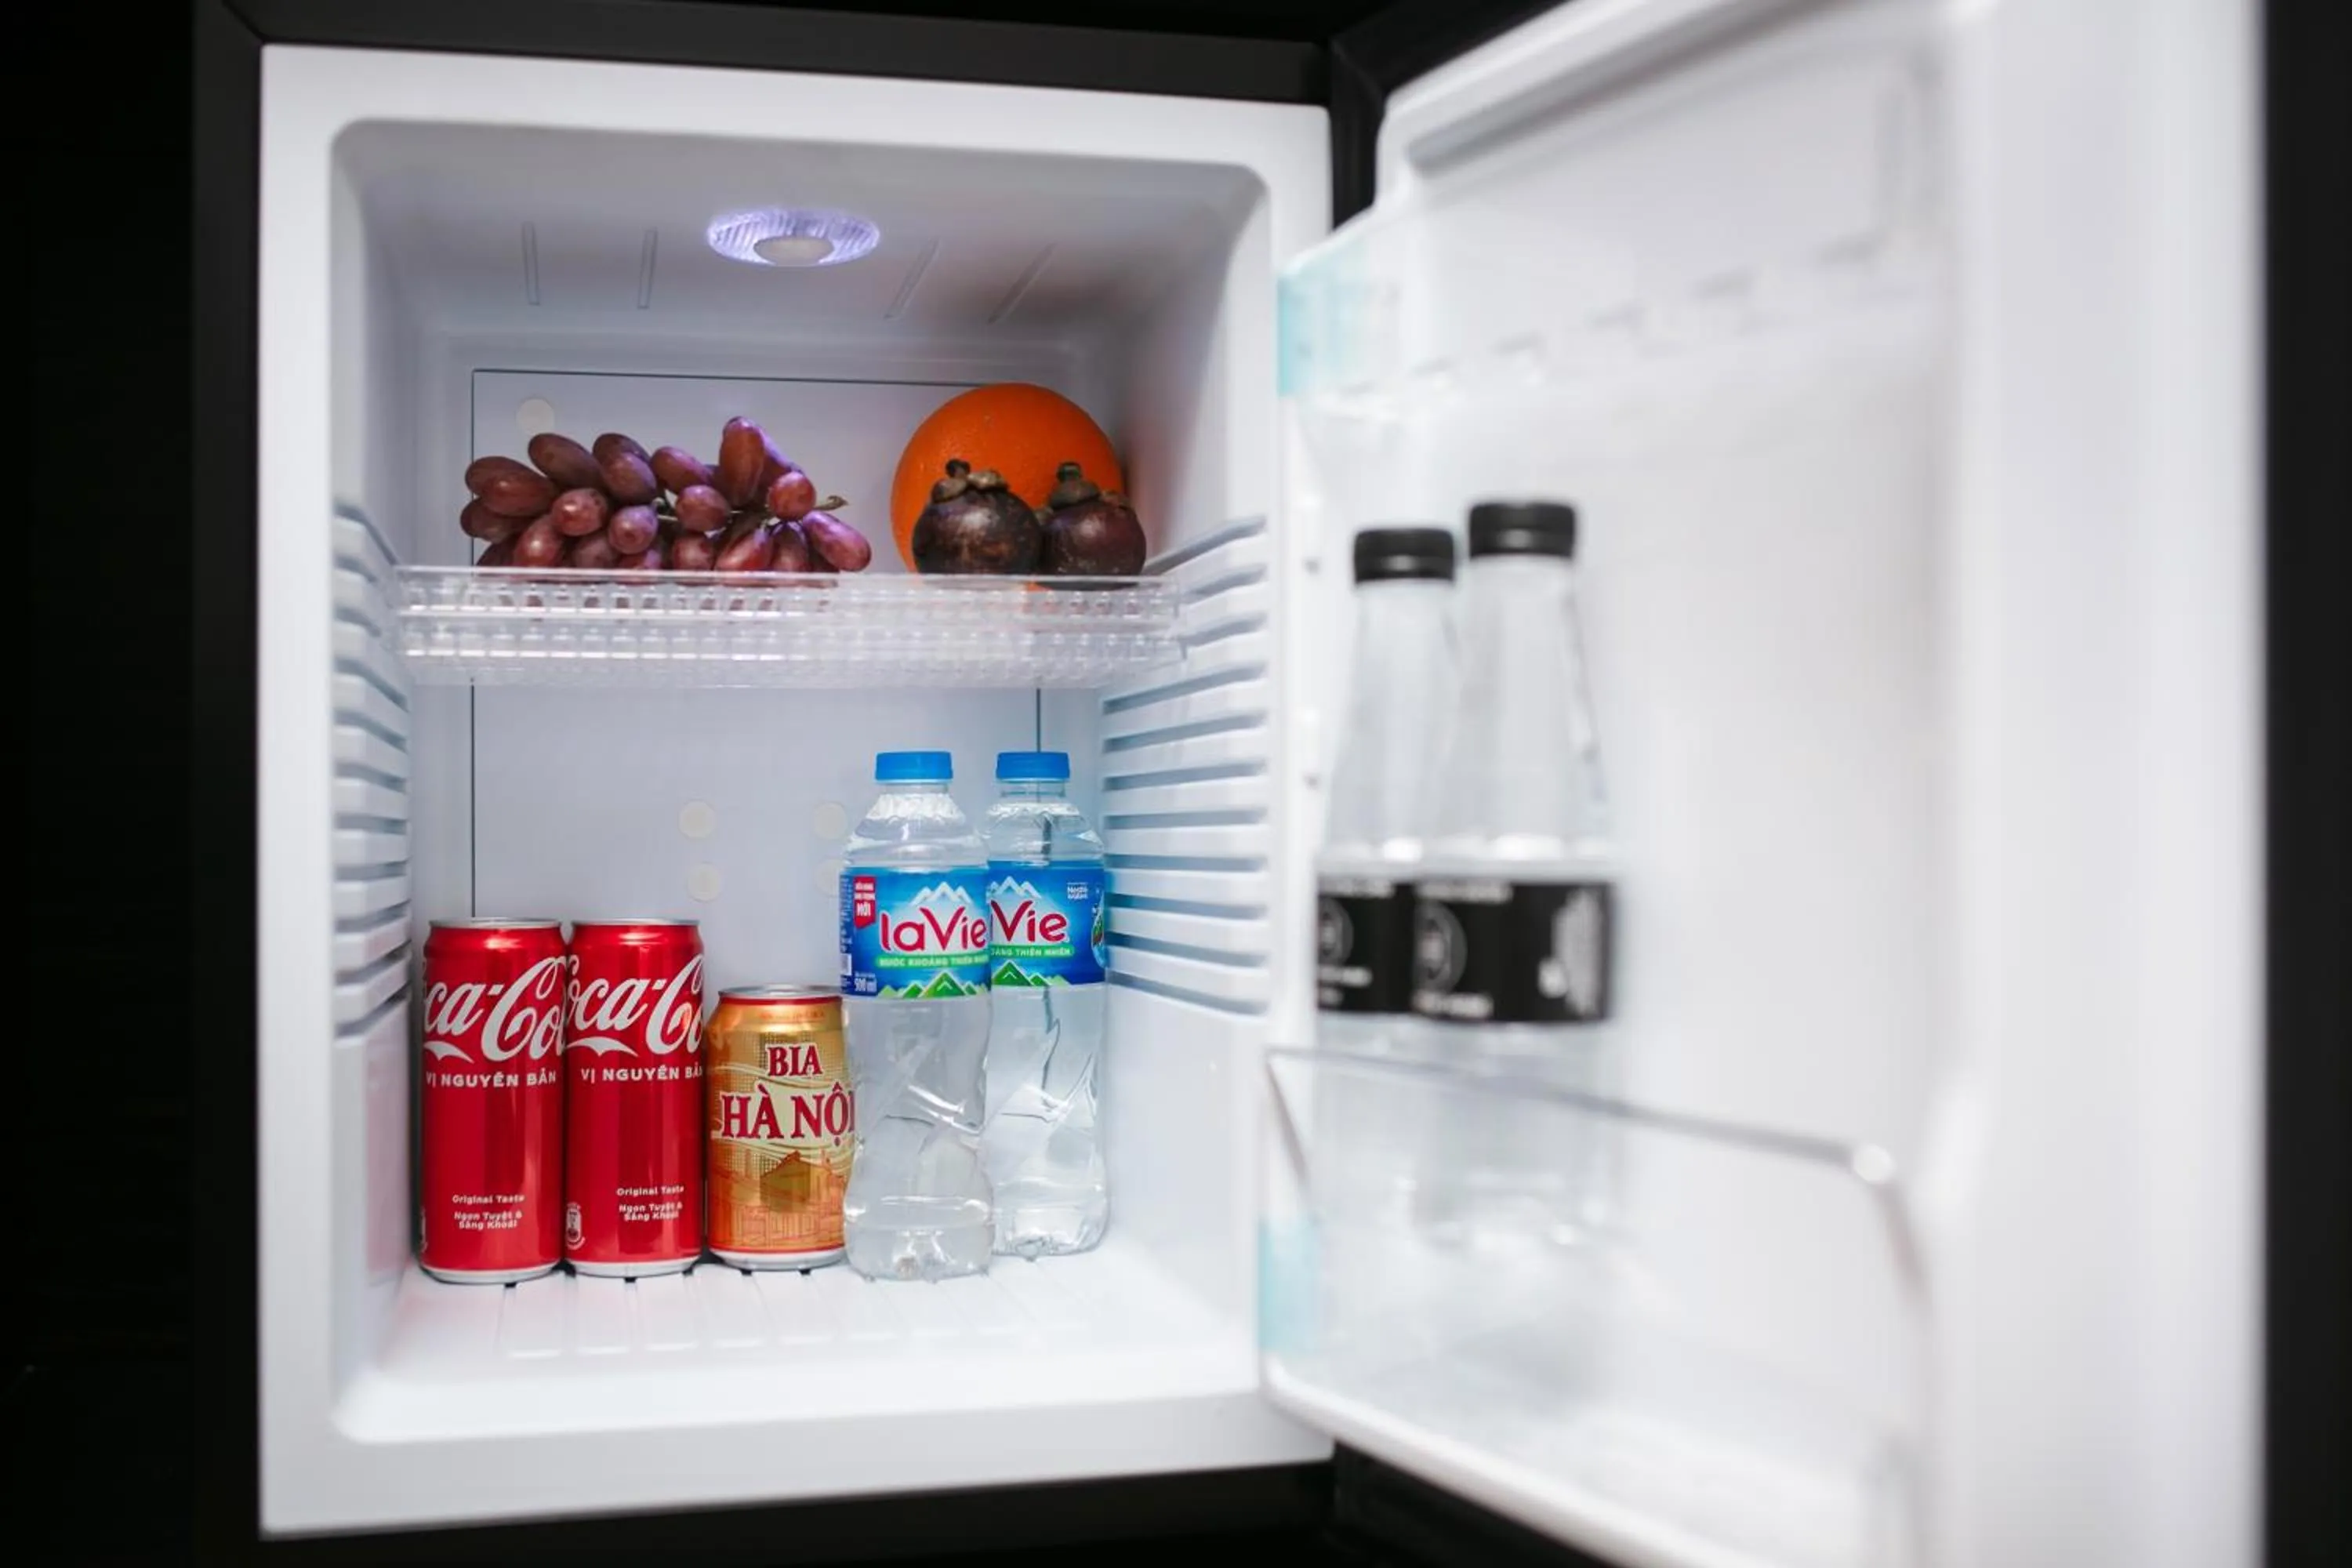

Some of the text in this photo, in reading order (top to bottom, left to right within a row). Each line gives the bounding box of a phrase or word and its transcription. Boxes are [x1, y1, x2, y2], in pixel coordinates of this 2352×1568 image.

[880, 906, 987, 952] laVie
[990, 900, 1067, 942] Vie
[768, 1045, 822, 1077] BIA
[441, 1071, 519, 1087] NGUYÊN
[526, 1067, 556, 1087] BẢN
[581, 1068, 595, 1084] VỊ
[602, 1065, 680, 1082] NGUYÊN
[721, 1082, 855, 1146] HÀ NỘI
[452, 1194, 525, 1205] Original Taste
[616, 1185, 684, 1197] Original Taste
